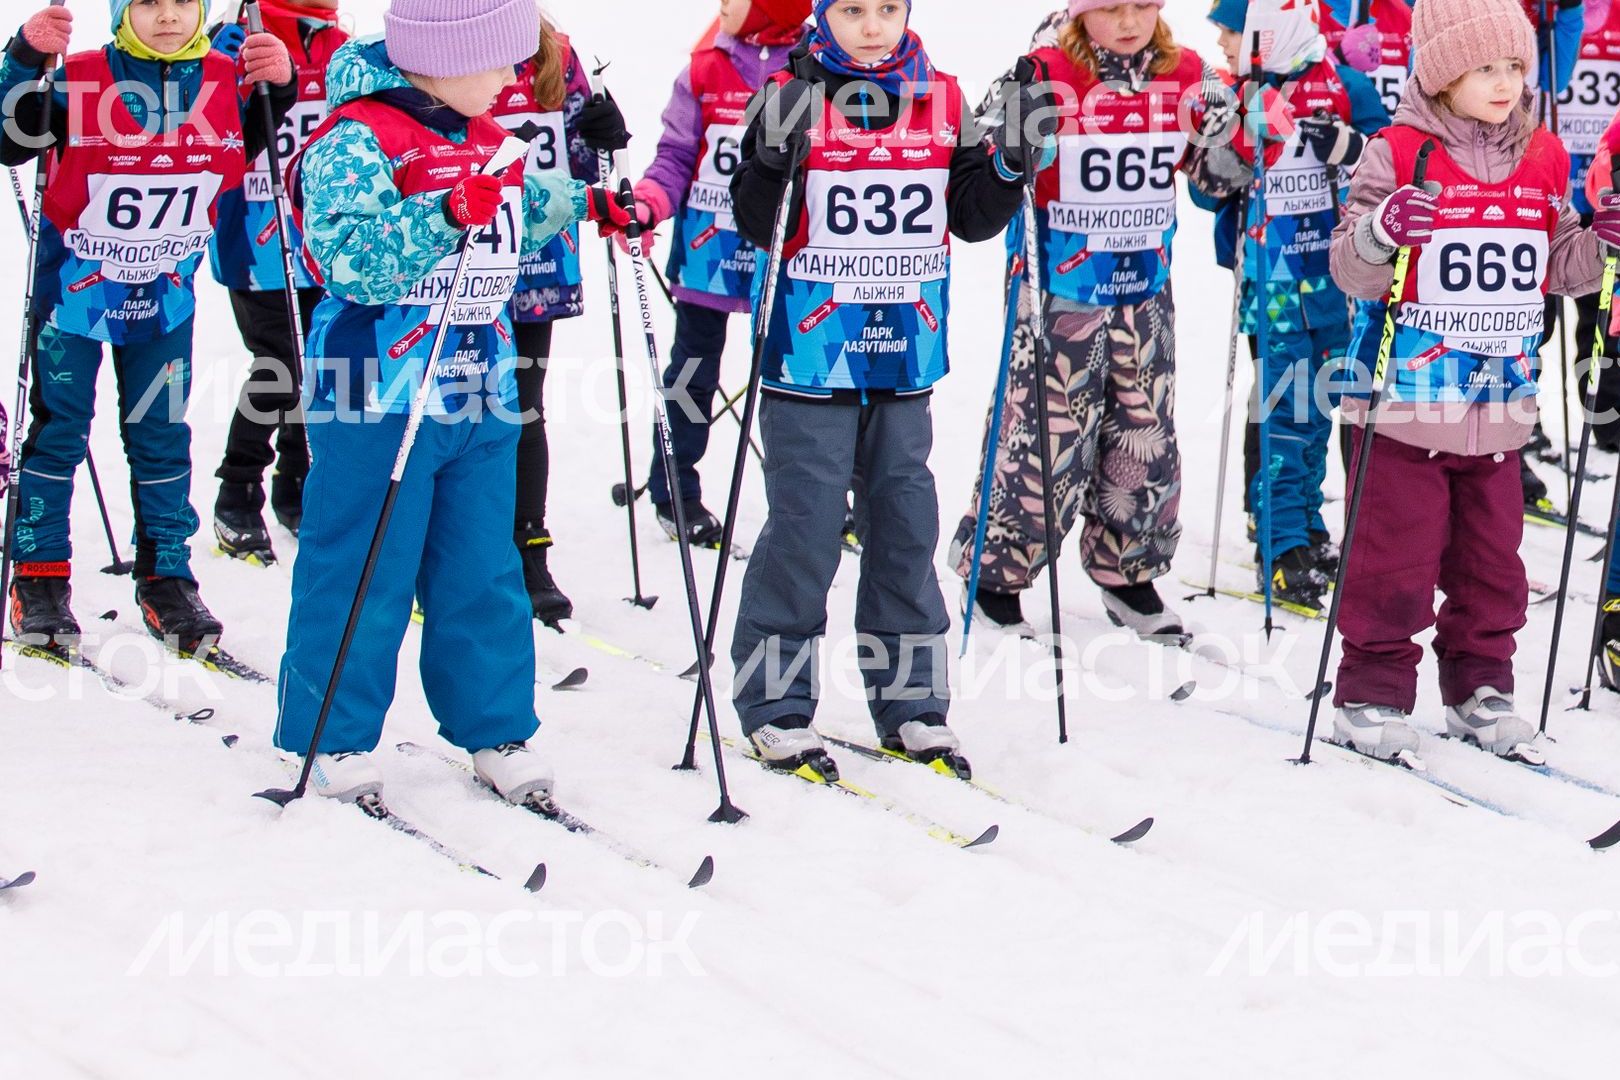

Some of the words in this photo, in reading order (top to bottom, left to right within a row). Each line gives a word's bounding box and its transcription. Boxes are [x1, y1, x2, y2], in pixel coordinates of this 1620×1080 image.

[1080, 147, 1175, 192] 665
[107, 186, 199, 230] 671
[827, 184, 933, 235] 632
[1283, 197, 1327, 212] ЛЫЖНЯ
[1104, 235, 1147, 249] ЛЫЖНЯ
[1295, 230, 1320, 242] ПАРК
[1280, 240, 1332, 255] ЛАЗУТИНО
[793, 253, 945, 277] МАНЖОСОВСКАЯ
[1439, 242, 1537, 292] 669
[117, 270, 159, 281] ЛЫЖН
[1112, 270, 1137, 283] ПАРК
[853, 286, 905, 300] ЛЫЖНЯ
[123, 300, 152, 310] ПАРК
[863, 327, 893, 340] ПАРК
[844, 336, 908, 354] ЛАЗУТИНОЙ
[455, 349, 481, 363] ПАРК
[27, 563, 71, 574] ROSSIGNO
[311, 758, 331, 788] RDWAY
